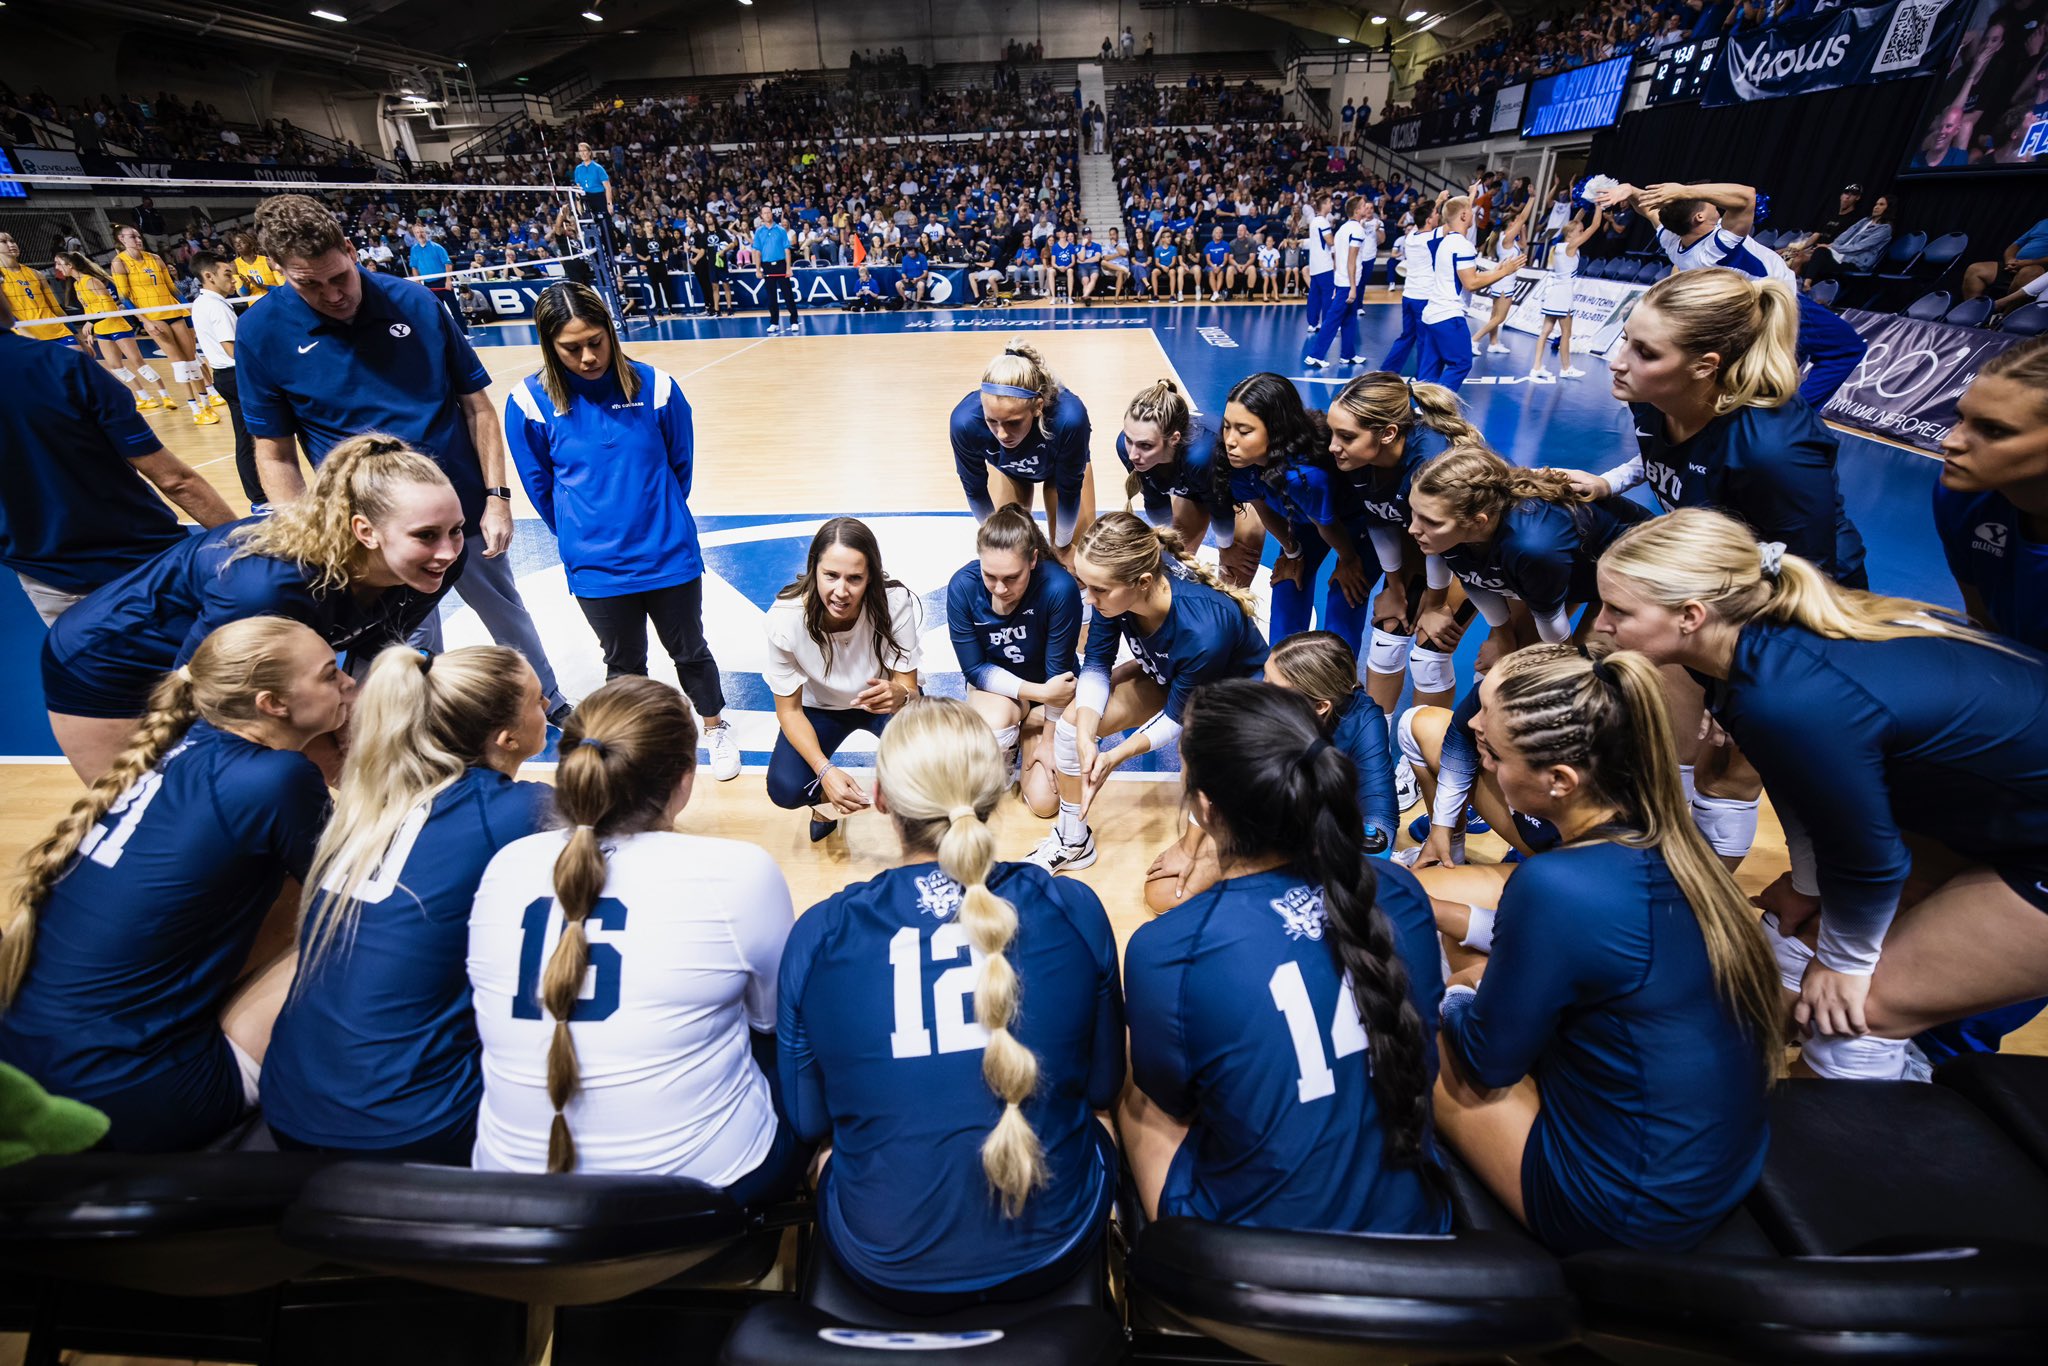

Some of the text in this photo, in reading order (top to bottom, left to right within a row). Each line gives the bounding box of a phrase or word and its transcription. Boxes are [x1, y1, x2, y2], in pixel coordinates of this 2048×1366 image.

[1701, 37, 1720, 51] GUEST
[1564, 60, 1630, 101] BYU NIKE
[1532, 91, 1622, 137] INVITATIONAL
[37, 165, 83, 173] LOVELAND
[25, 287, 35, 300] 8
[150, 274, 157, 286] 7
[1646, 459, 1683, 501] BYU
[989, 625, 1027, 645] BYU
[512, 896, 628, 1022] 16
[890, 922, 993, 1060] 12
